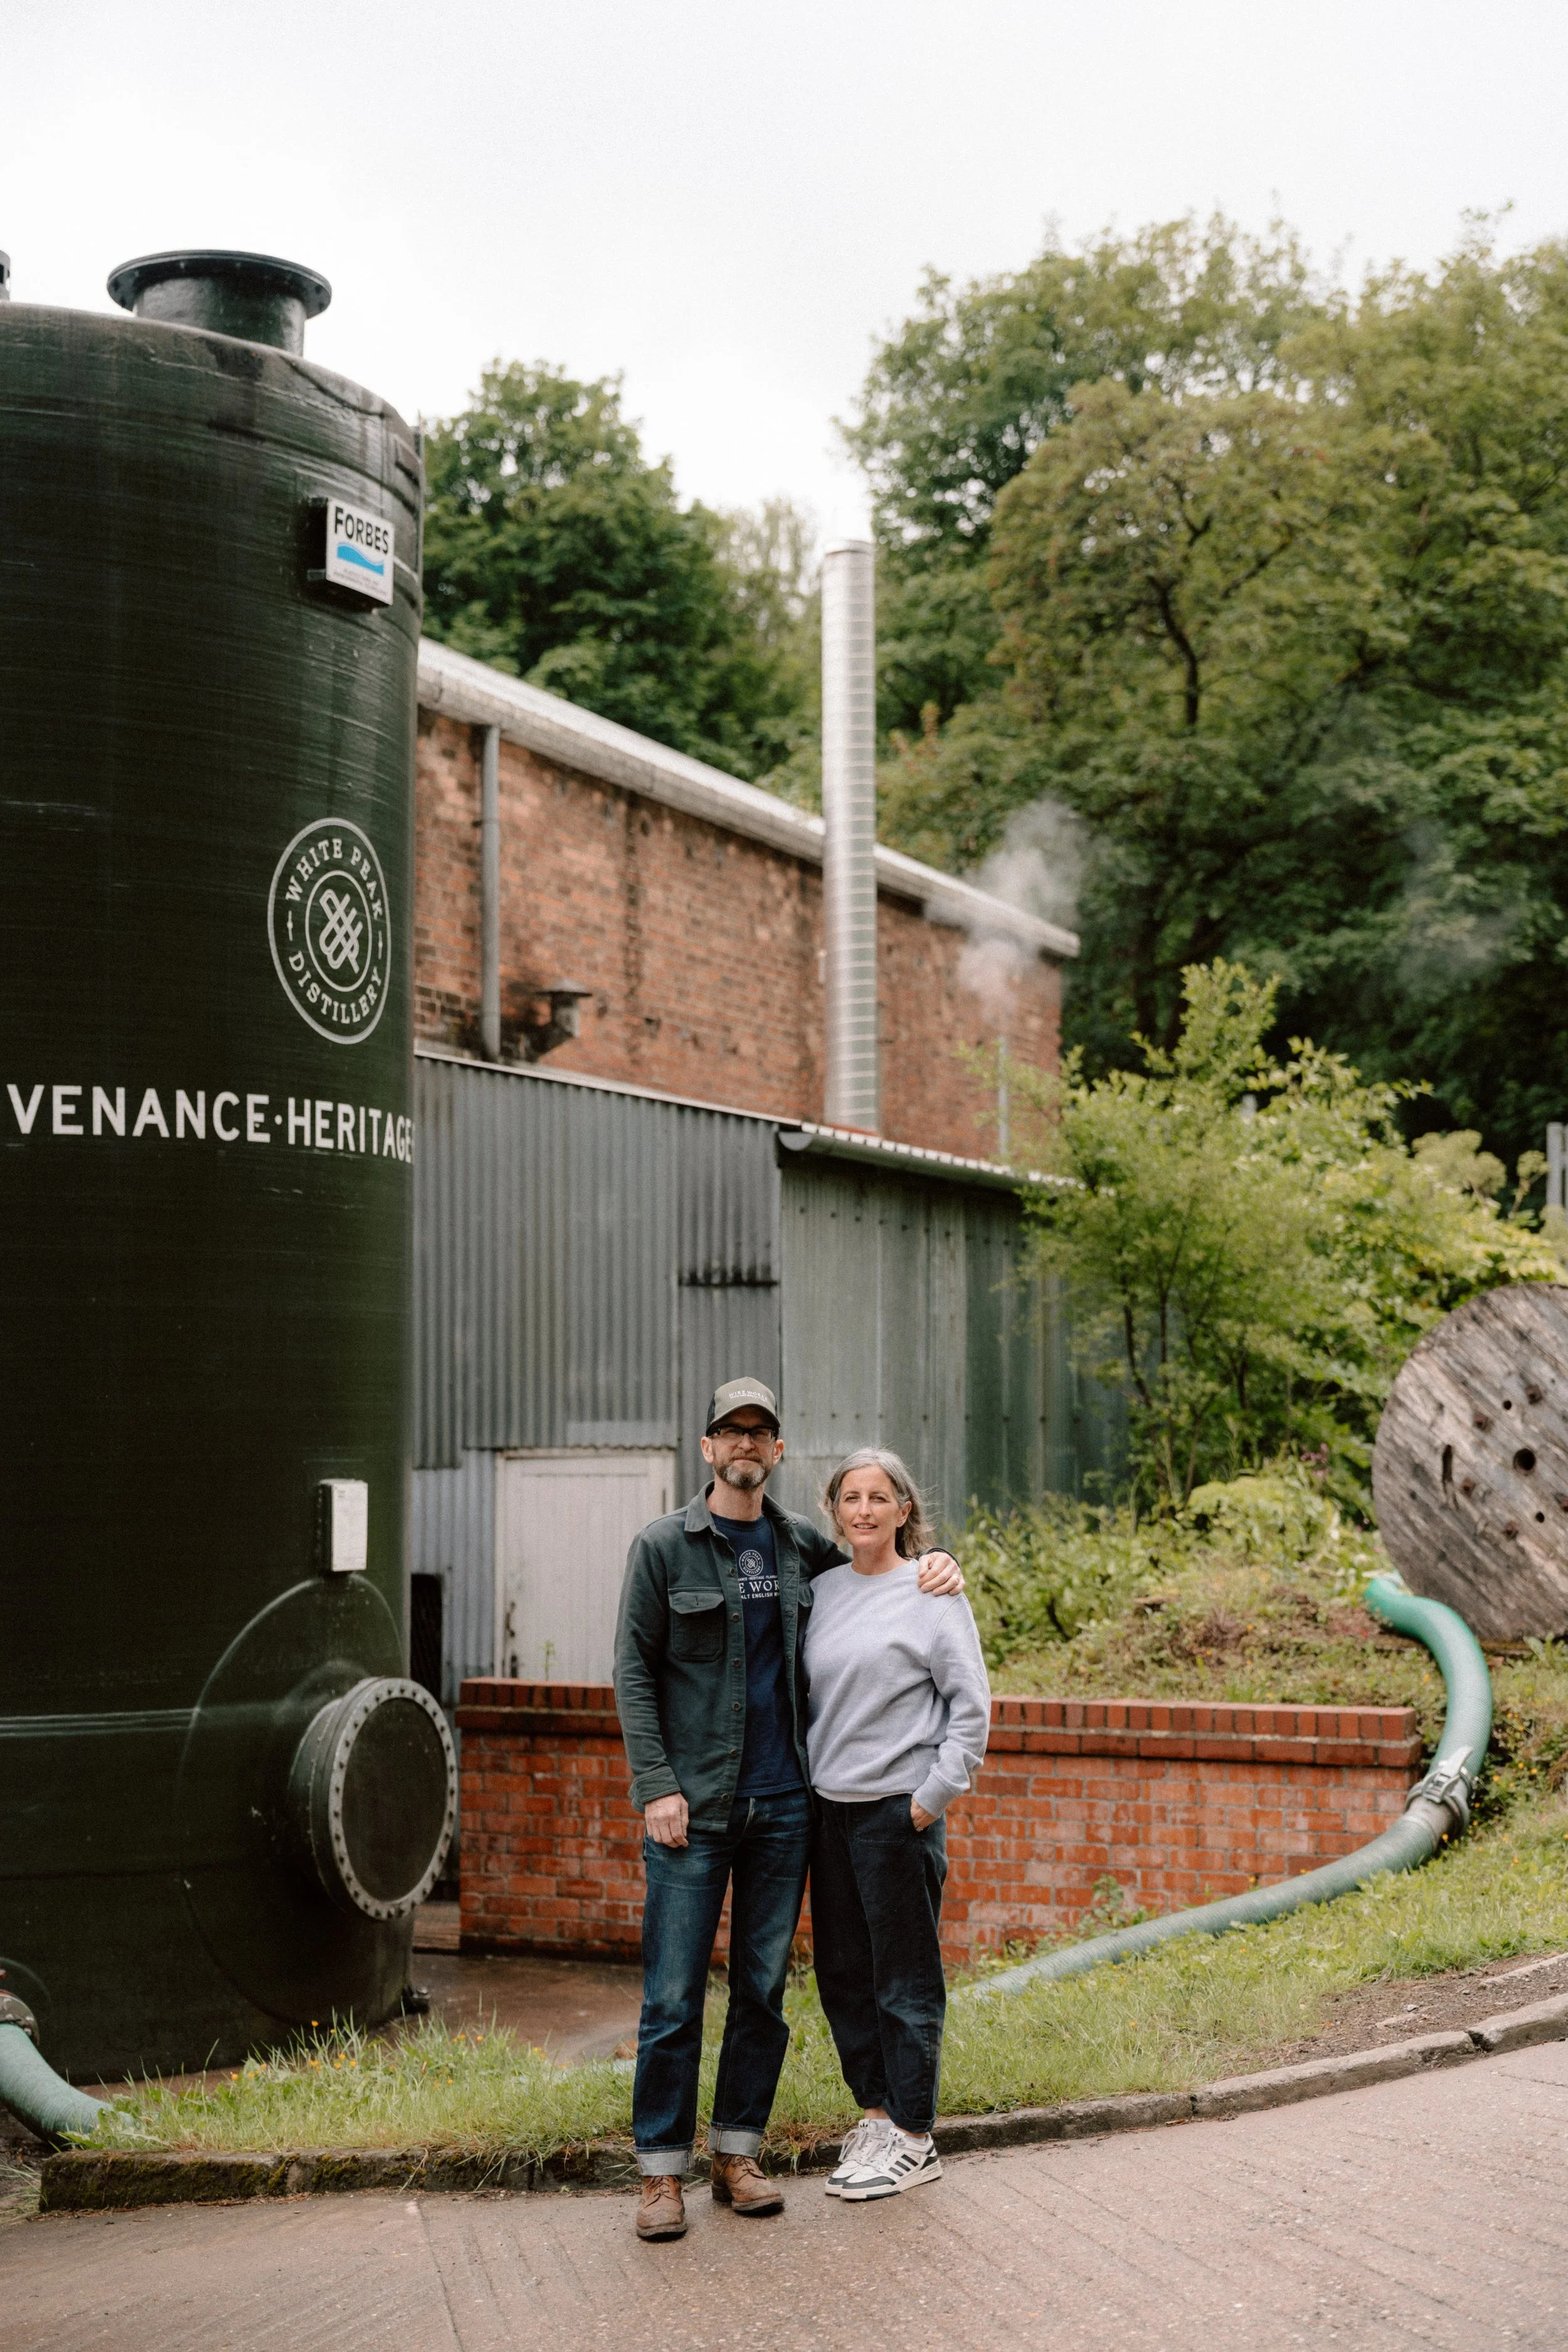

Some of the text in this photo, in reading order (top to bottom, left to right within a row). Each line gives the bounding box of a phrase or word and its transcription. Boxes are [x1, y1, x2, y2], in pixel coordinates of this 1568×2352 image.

[335, 506, 388, 554] FORBES
[285, 838, 383, 920] WHITE PEAK
[289, 950, 381, 1024] DISTILLERY
[741, 1552, 760, 1562] WHITE PEAK
